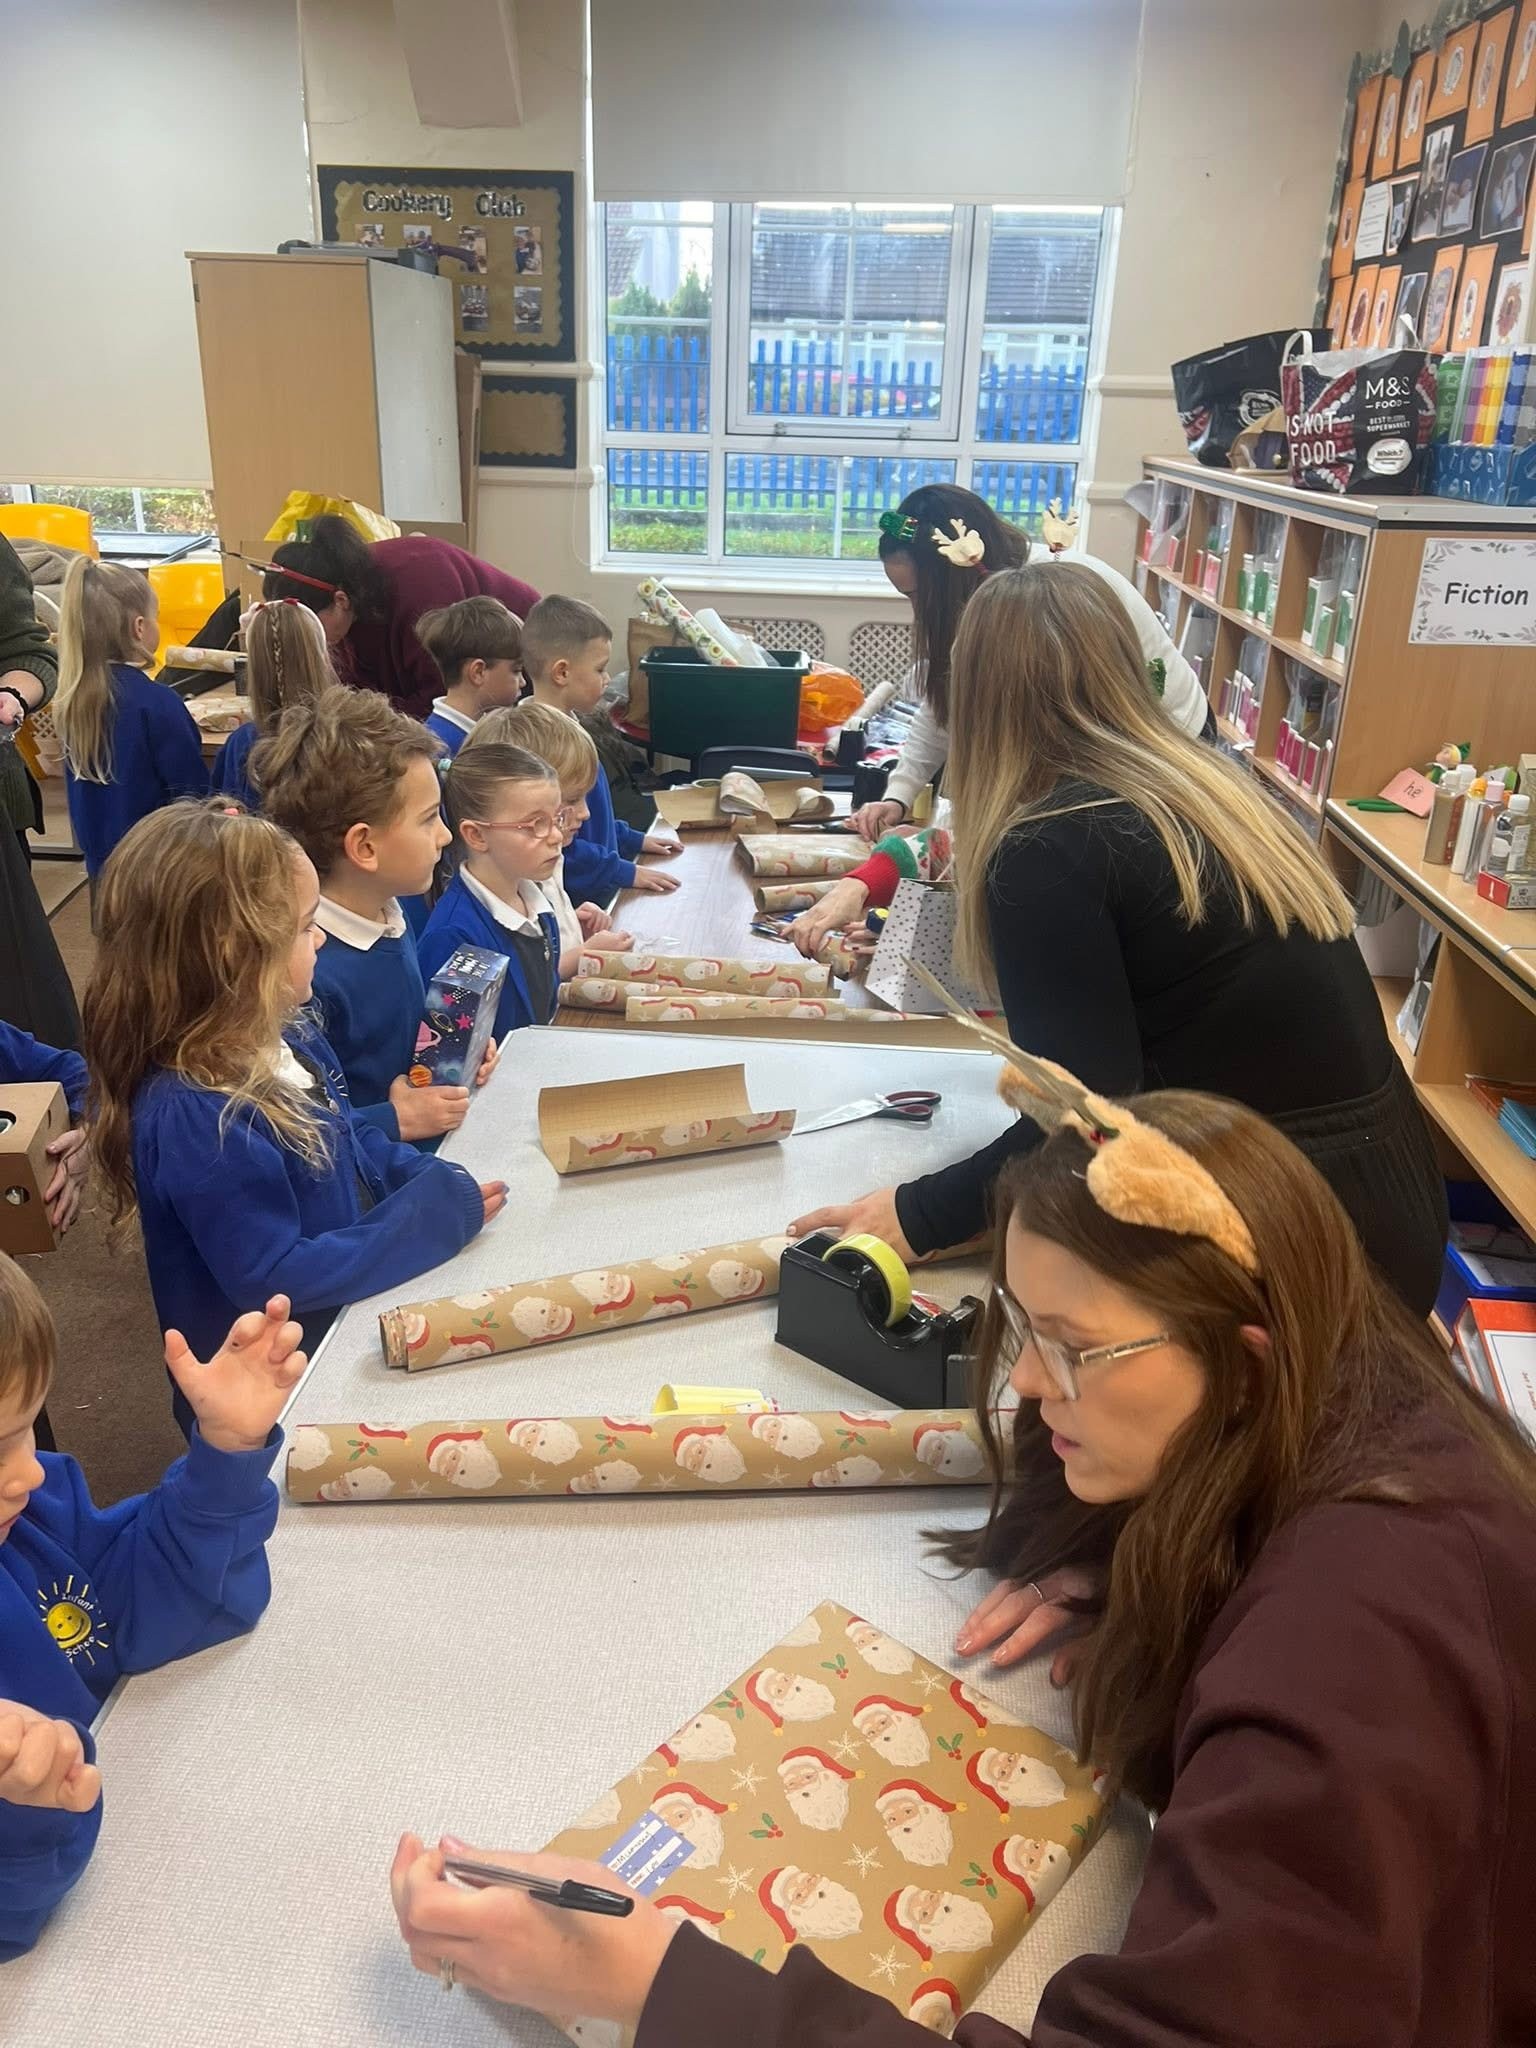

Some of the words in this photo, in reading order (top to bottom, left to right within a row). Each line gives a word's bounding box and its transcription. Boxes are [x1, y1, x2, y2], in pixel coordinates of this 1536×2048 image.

[362, 189, 452, 221] Cookery
[476, 192, 527, 217] Club
[1365, 376, 1410, 400] M&S
[1375, 399, 1402, 409] FOOD
[1303, 411, 1337, 435] NOT
[1366, 421, 1411, 432] SUPERMARKET
[1369, 416, 1387, 425] BEST
[1291, 440, 1336, 466] FOOD
[1444, 582, 1529, 605] Fiction
[1403, 780, 1422, 799] he
[61, 1593, 94, 1610] Infant
[65, 1634, 95, 1657] Schoo
